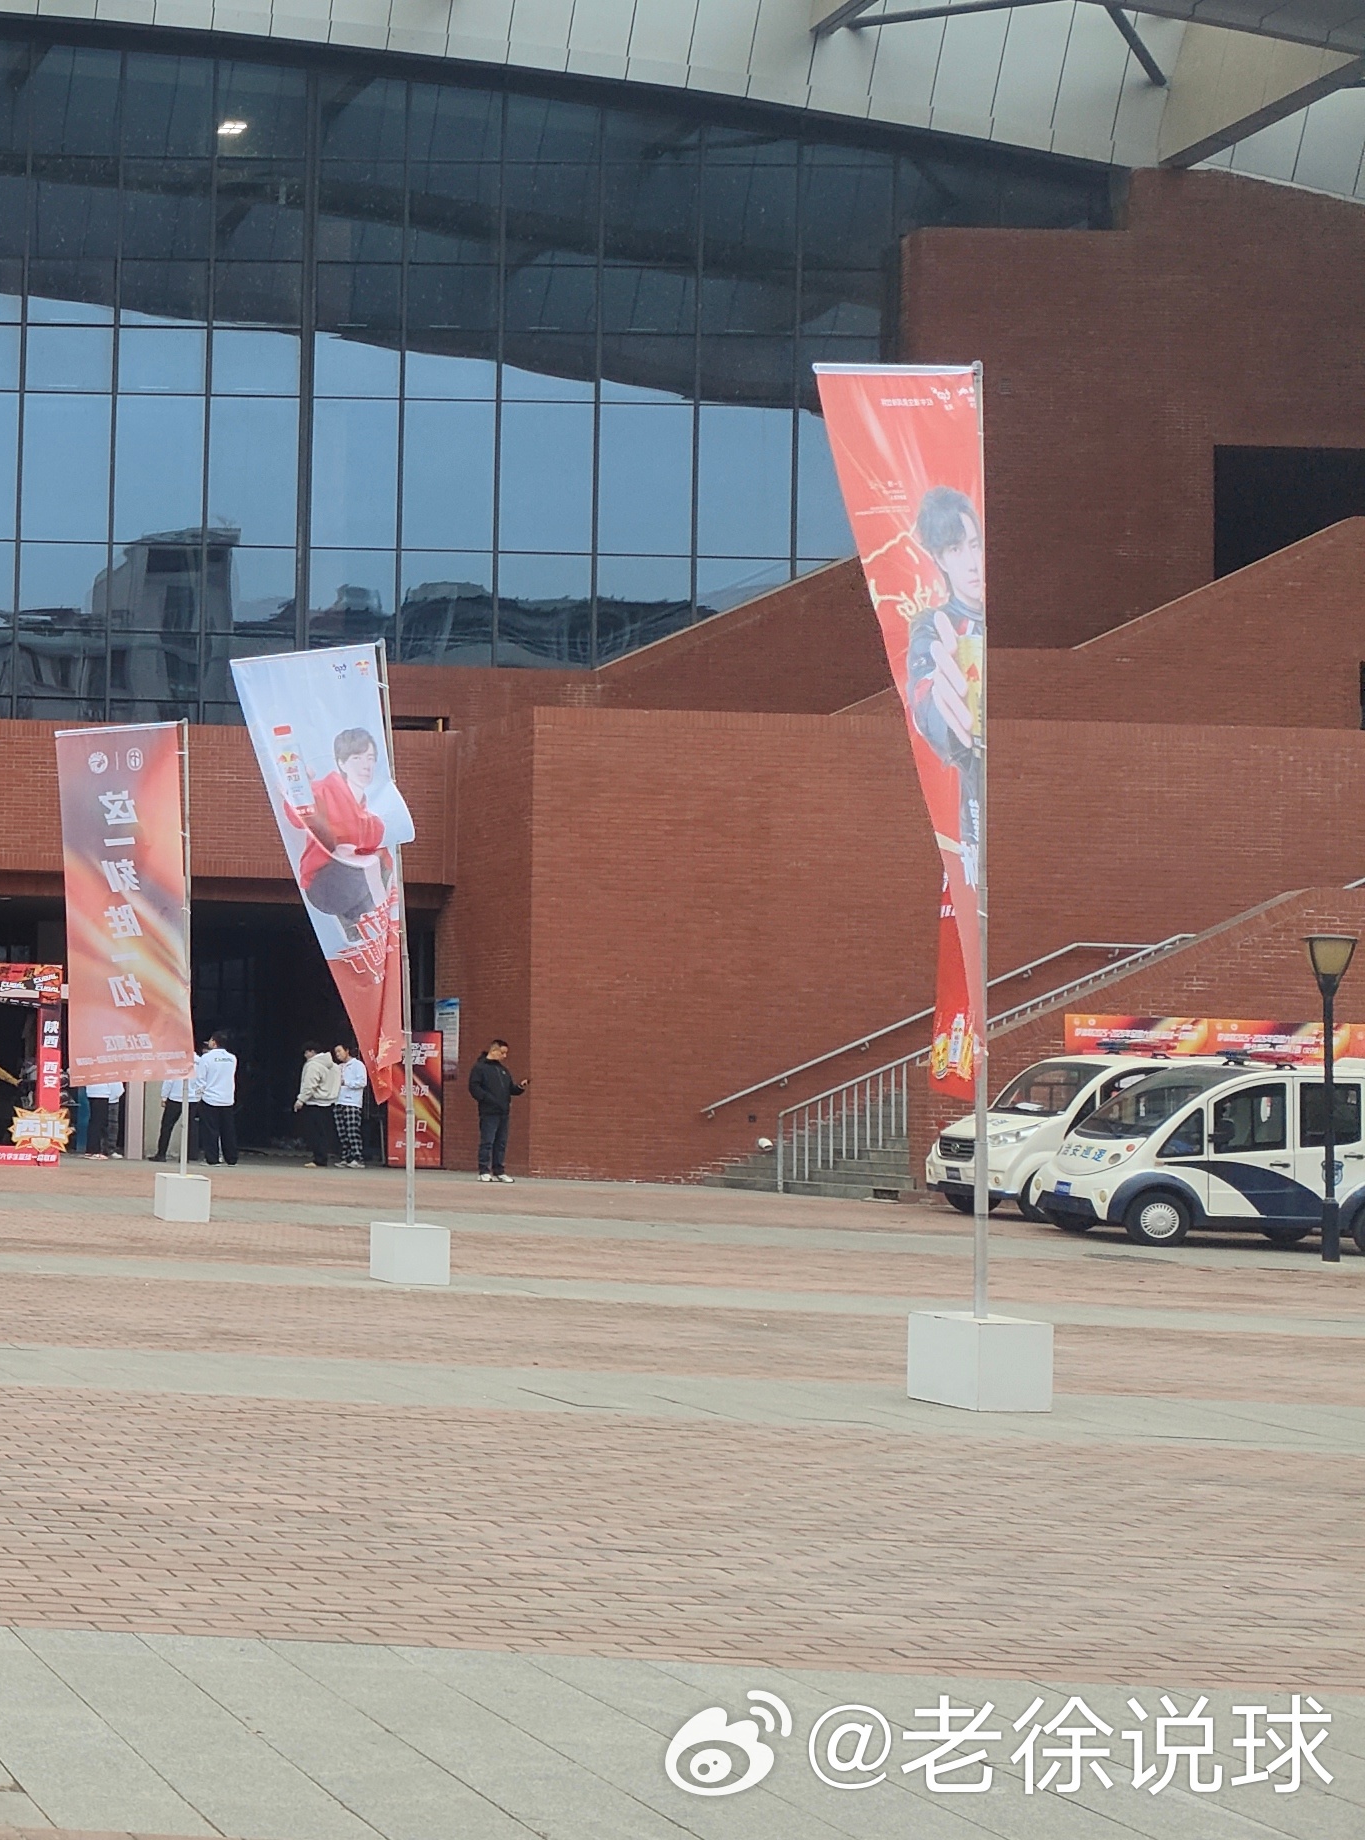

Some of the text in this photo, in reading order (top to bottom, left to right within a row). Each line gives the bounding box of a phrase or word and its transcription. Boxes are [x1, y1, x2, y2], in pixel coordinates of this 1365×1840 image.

[43, 1061, 58, 1088] 西安
[15, 1119, 67, 1139] 西北
[404, 1120, 427, 1132] 口
